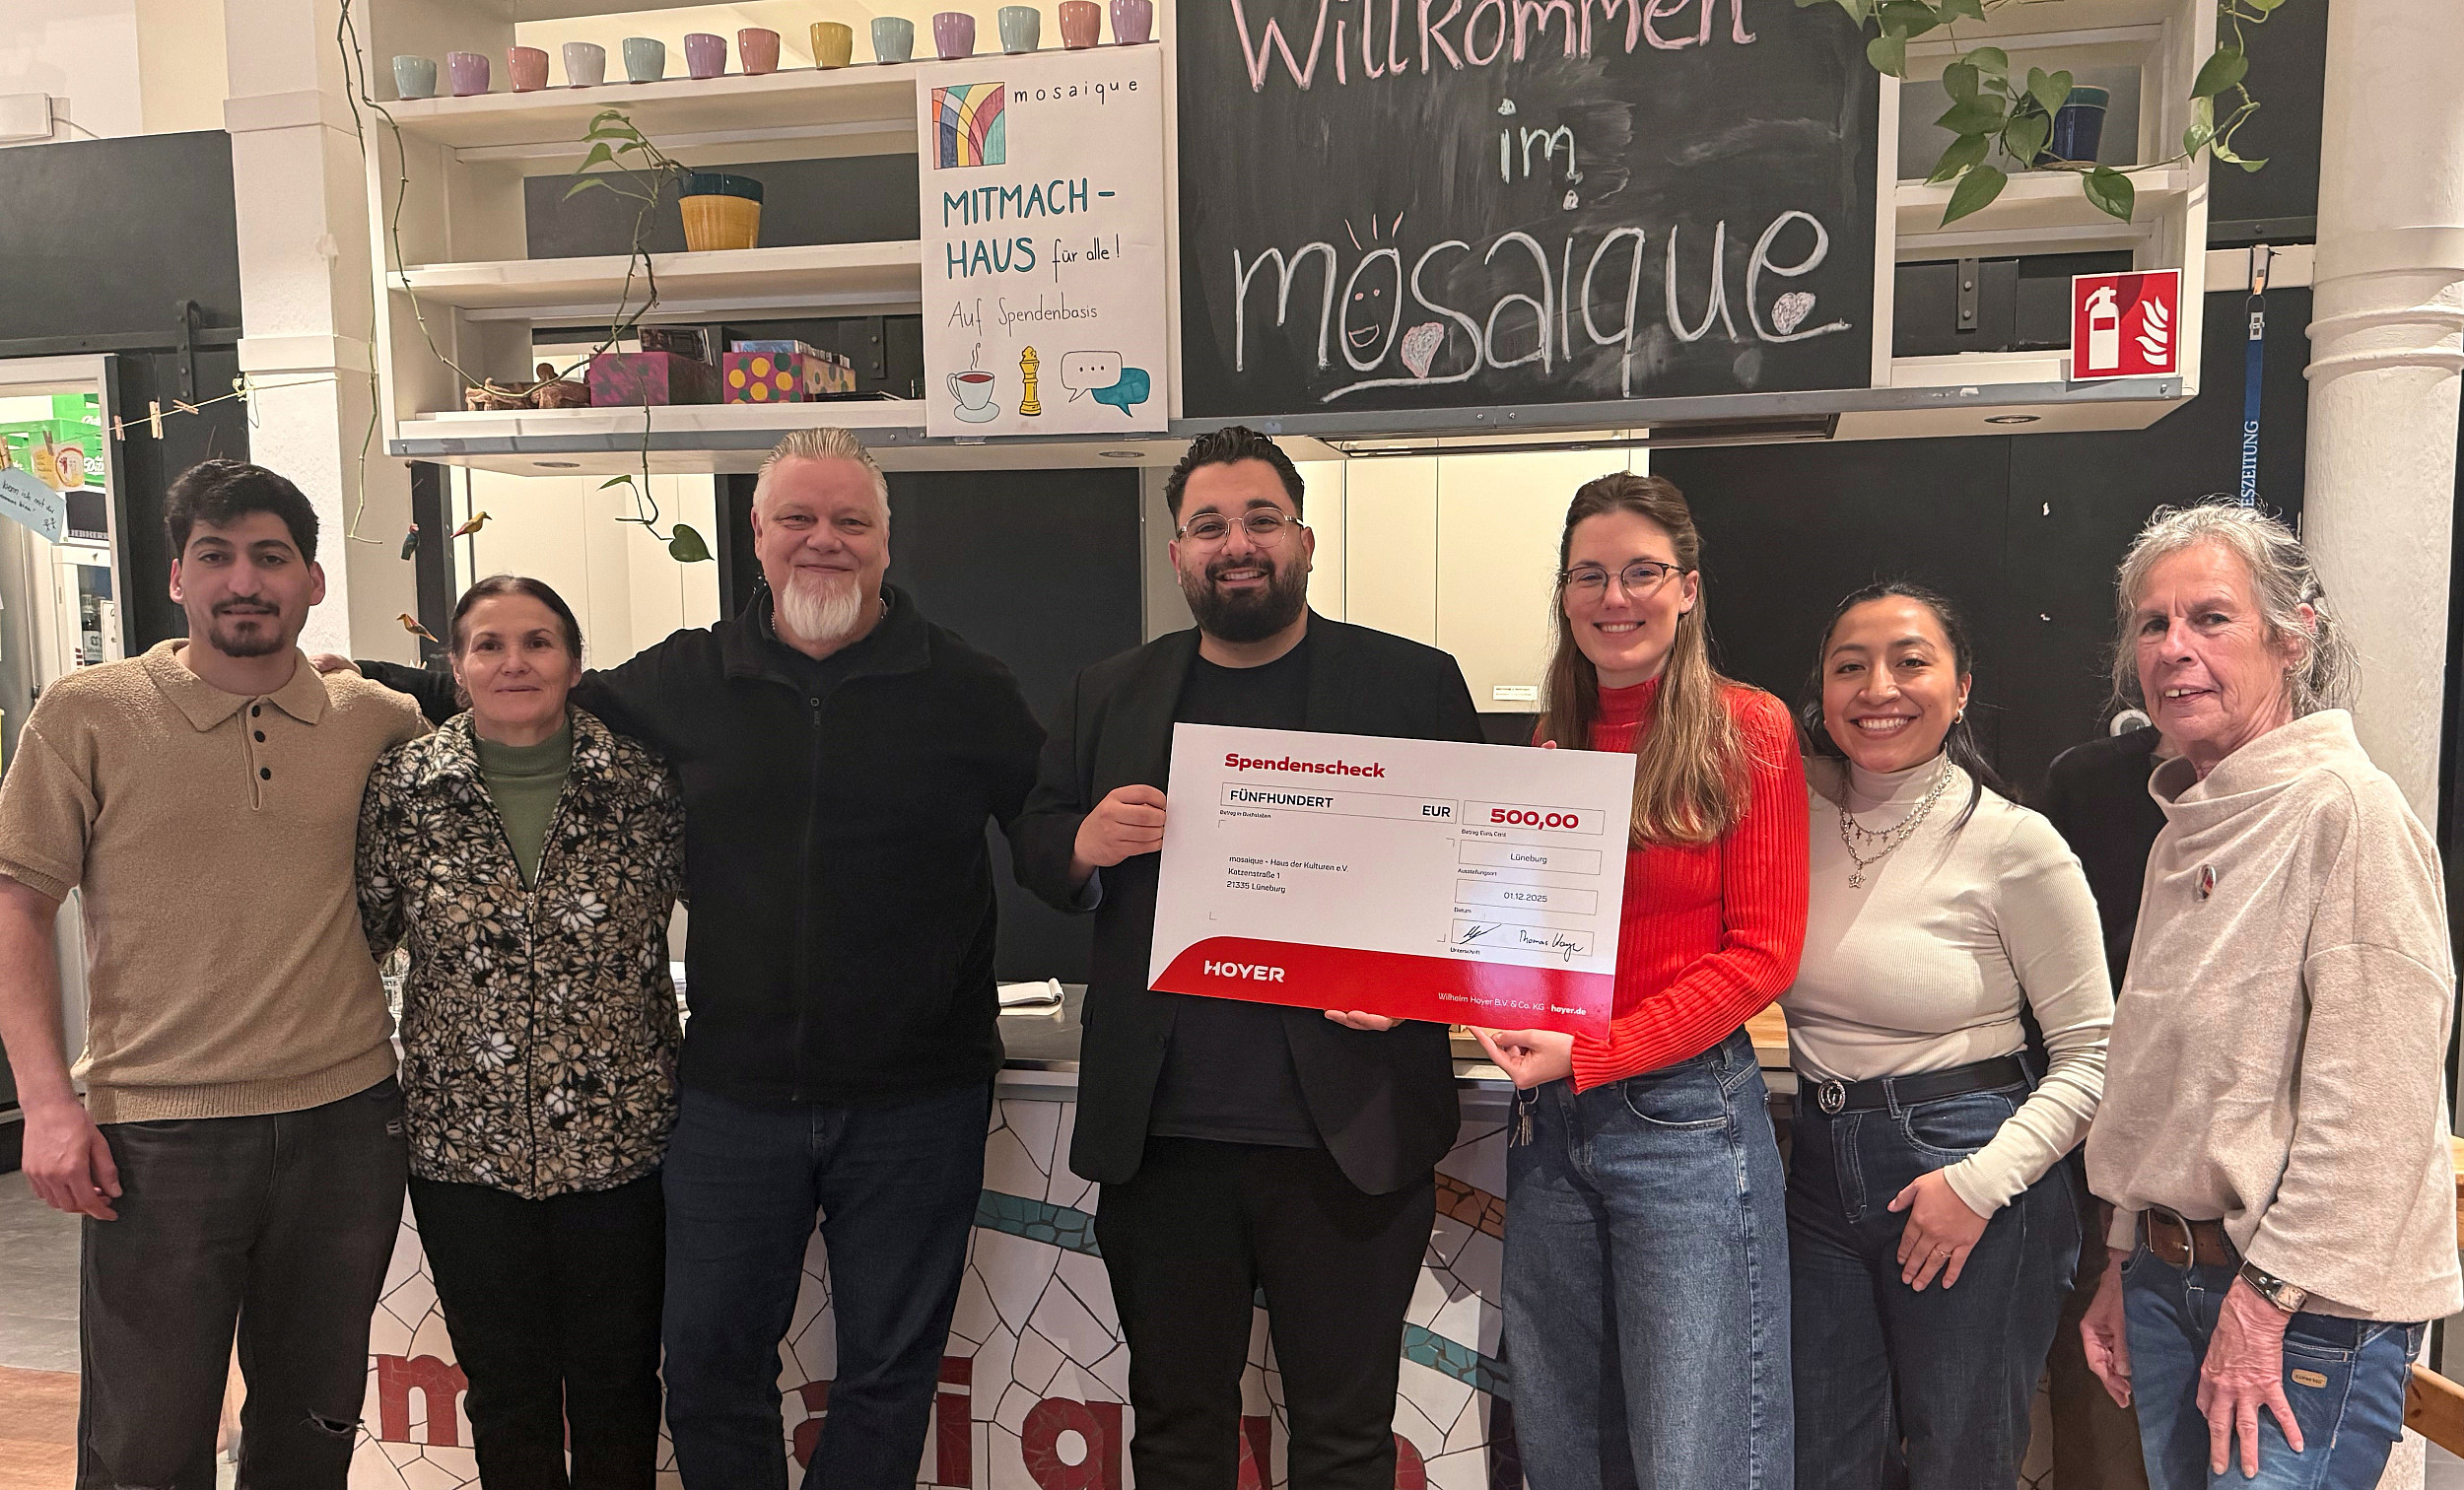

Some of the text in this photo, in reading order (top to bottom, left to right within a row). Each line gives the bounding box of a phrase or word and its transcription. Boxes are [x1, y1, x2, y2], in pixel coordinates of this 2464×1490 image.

[1014, 80, 1138, 104] mosaique
[1498, 99, 1582, 184] im
[946, 237, 1037, 279] HAUS
[1052, 238, 1078, 283] für
[1232, 189, 1851, 401] mosaique
[947, 292, 1098, 337] Auf Spendenbasis
[1225, 753, 1386, 779] Spendenscheck
[1230, 788, 1451, 818] FÜNFHUNDERT EUR
[1490, 808, 1579, 830] 500,00
[1229, 855, 1264, 867] mosaique
[1270, 858, 1288, 867] Haus
[1290, 859, 1302, 868] der
[1303, 860, 1335, 871] Kulturen
[1510, 852, 1547, 864] Lüneburg
[1226, 880, 1286, 894] 21335 Lüneburg
[1503, 891, 1547, 903] 01.12.2025
[1203, 960, 1285, 982] HOYER
[1438, 992, 1469, 1003] Wilhelm
[1470, 994, 1494, 1006] Hoyer
[1532, 1002, 1544, 1011] KG
[1550, 1003, 1586, 1016] hoyer.de
